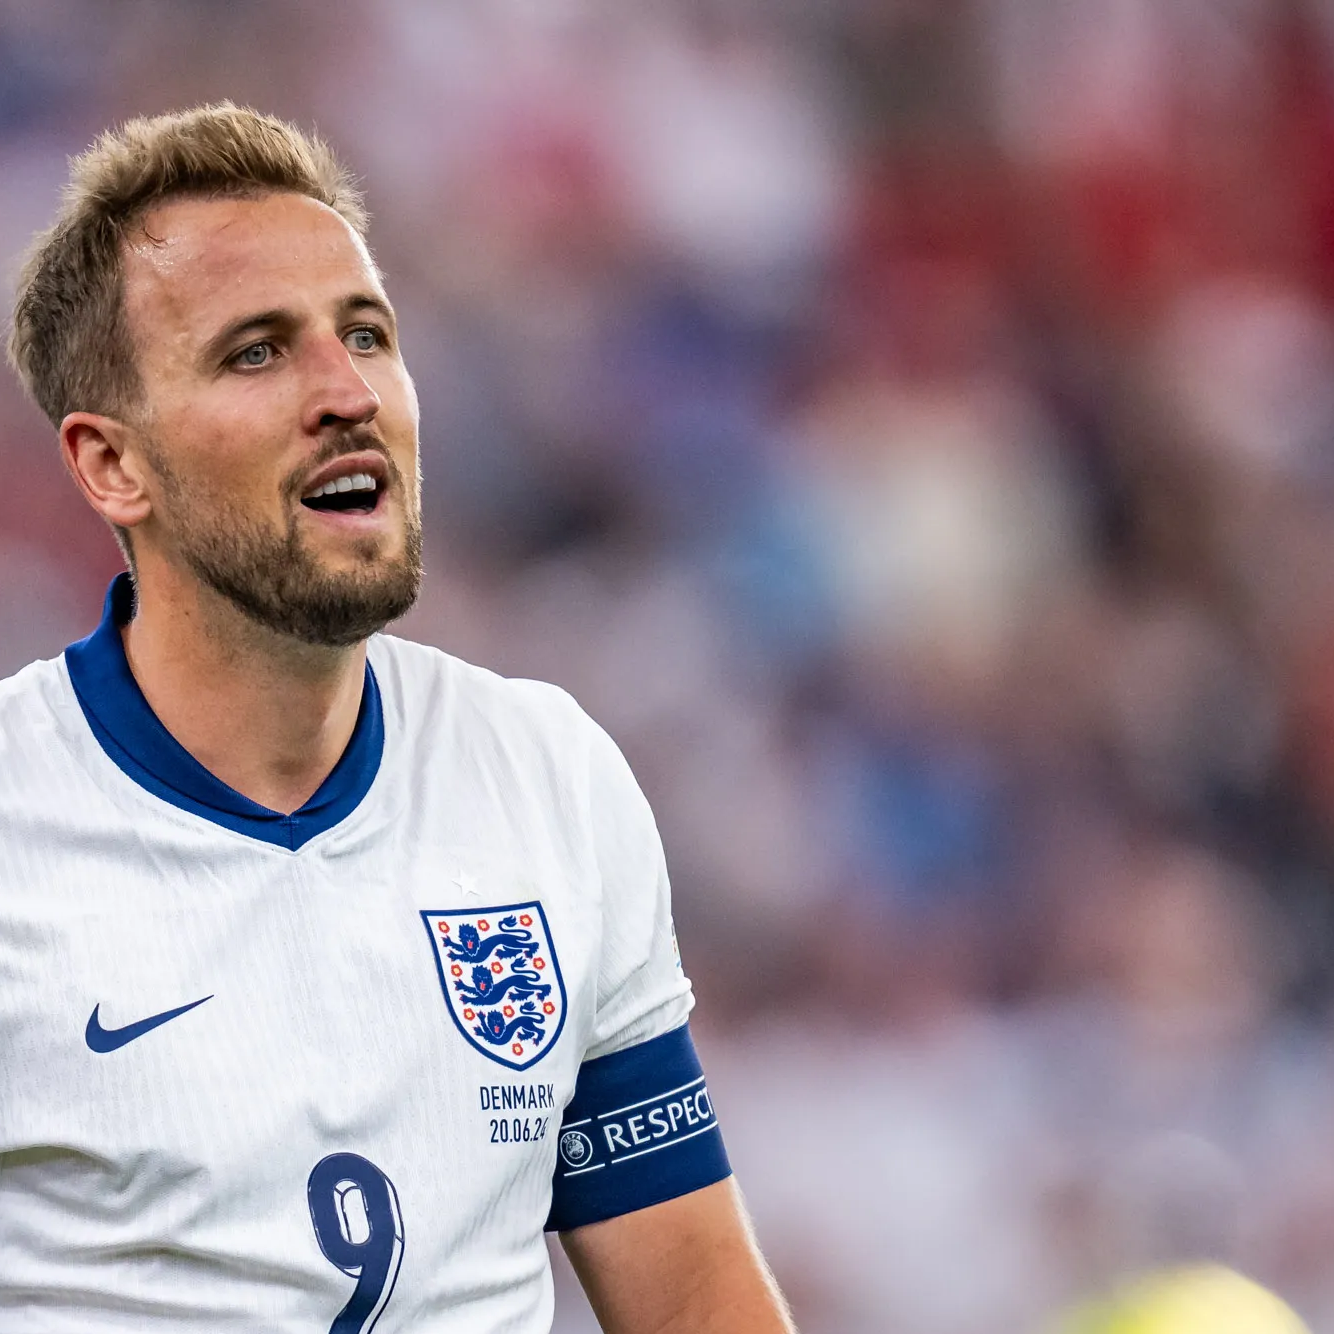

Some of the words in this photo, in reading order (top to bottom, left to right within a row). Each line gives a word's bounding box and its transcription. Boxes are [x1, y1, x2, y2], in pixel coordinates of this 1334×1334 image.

[479, 1083, 555, 1110] DENMARK
[489, 1116, 549, 1143] 20.06.24
[603, 1086, 714, 1153] RESPECT
[562, 1133, 581, 1144] UEFA
